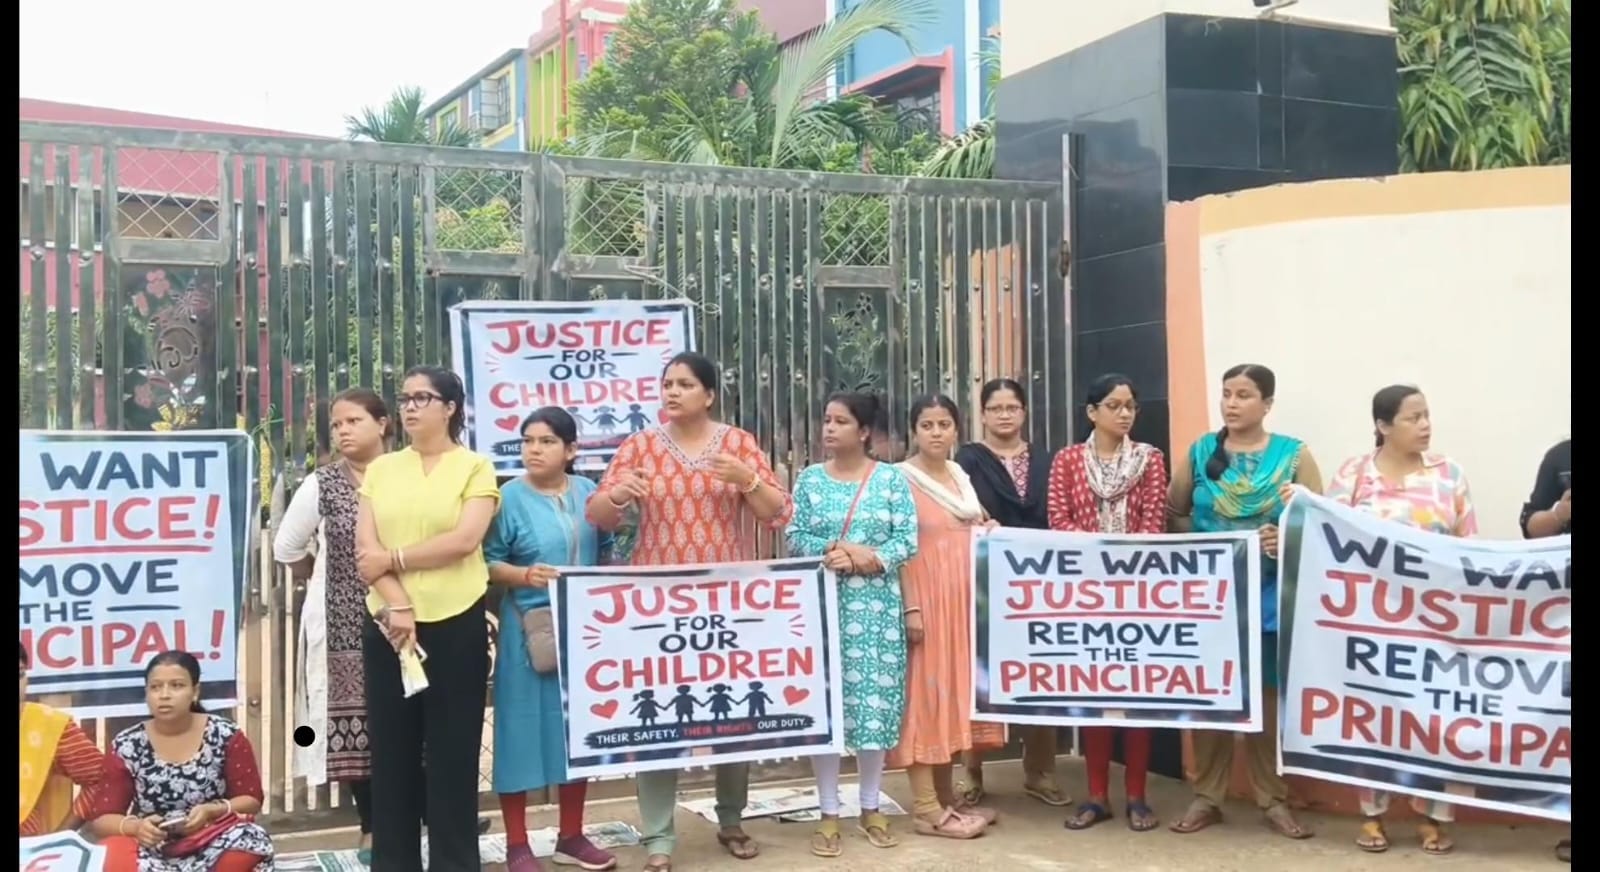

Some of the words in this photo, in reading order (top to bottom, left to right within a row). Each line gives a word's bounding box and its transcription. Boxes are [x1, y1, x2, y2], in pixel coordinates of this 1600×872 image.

[485, 319, 670, 354] JUSTICE
[562, 349, 605, 362] FOR
[549, 362, 618, 380] OUR
[489, 376, 664, 409] CHILDRE
[501, 443, 521, 453] THE
[40, 450, 218, 491] WANT
[1003, 549, 1082, 575] WE
[1100, 549, 1226, 575] WANT
[1321, 522, 1430, 580] WE
[1460, 556, 1570, 590] WA
[587, 579, 802, 624] JUSTICE
[1006, 579, 1228, 611] JUSTICE!
[1320, 569, 1570, 639] JUSTIC
[20, 600, 93, 624] THE
[674, 614, 727, 632] FOR
[659, 630, 740, 653] OUR
[1028, 621, 1199, 646] REMOVE
[1084, 647, 1139, 662] THE
[585, 646, 814, 692] CHILDREN
[1000, 660, 1234, 695] PRINCIPAL!
[1424, 687, 1504, 716] THE
[596, 734, 629, 745] THEIR
[634, 729, 679, 741] SAFETY.
[757, 720, 778, 730] OUR
[781, 718, 807, 727] DUTY.
